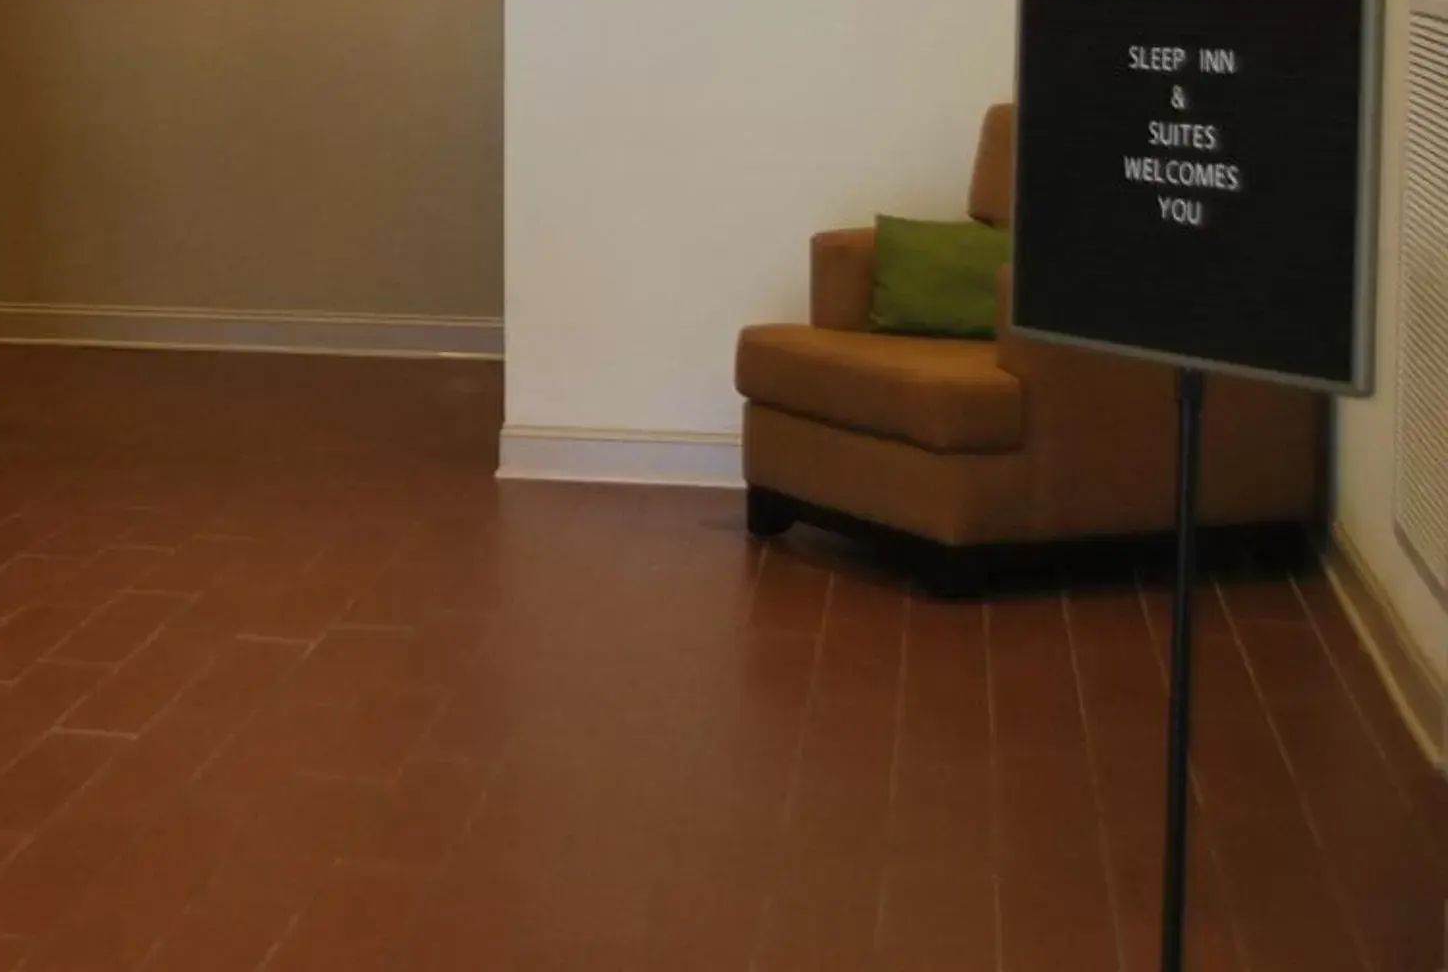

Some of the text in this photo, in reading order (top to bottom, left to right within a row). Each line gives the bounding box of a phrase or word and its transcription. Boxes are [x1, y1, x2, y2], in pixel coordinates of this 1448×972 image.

[1128, 46, 1235, 73] SLEEP INN
[1171, 85, 1185, 108] &
[1148, 120, 1216, 150] SUITES
[1124, 156, 1239, 190] WELCOMES
[1158, 197, 1202, 225] YOU
